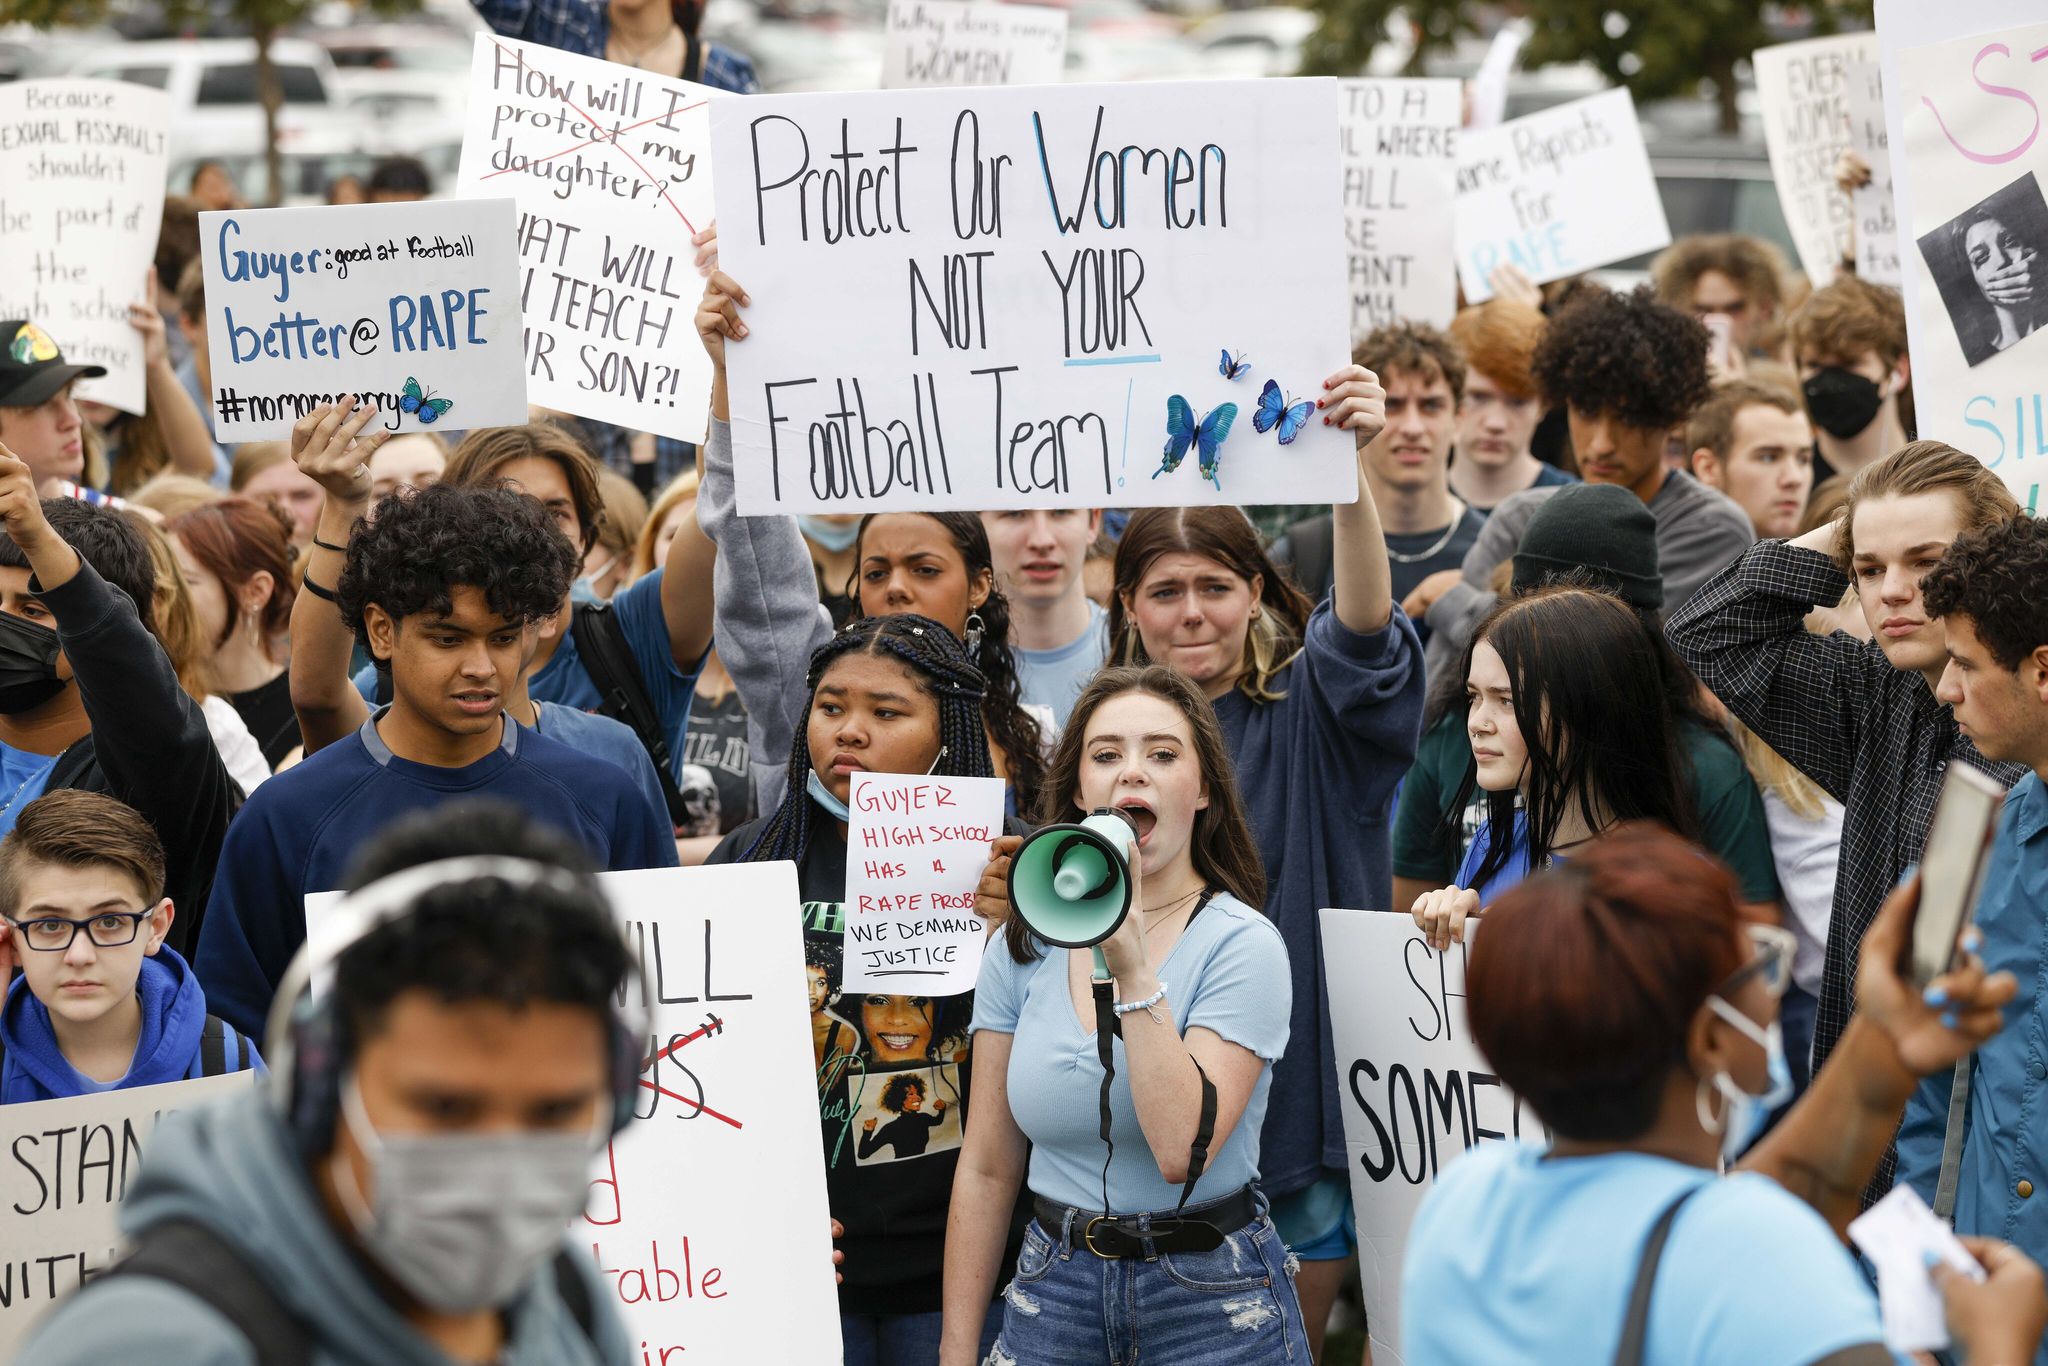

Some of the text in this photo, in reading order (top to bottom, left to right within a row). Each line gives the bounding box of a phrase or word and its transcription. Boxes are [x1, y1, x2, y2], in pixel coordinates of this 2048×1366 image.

[26, 87, 116, 111] Because
[494, 43, 686, 132] How will I
[1346, 85, 1385, 119] TO
[0, 119, 165, 154] EXUAL ASSAULT
[491, 104, 696, 183] protect my
[1377, 125, 1457, 158] WHERE
[491, 136, 669, 208] daughter?
[750, 104, 1227, 246] Protect Our Women
[1, 199, 31, 234] be
[57, 198, 113, 243] part
[377, 239, 400, 260] at
[602, 235, 680, 299] WILL
[33, 250, 87, 285] the
[388, 287, 491, 353] RAPE
[550, 272, 673, 349] TEACH
[908, 247, 1153, 359] NOT YOUR
[764, 372, 953, 502] Football
[856, 781, 957, 815] GUYER
[862, 824, 997, 848] HIGH SCHOOL
[865, 858, 946, 880] HAS A
[859, 893, 923, 914] RAPE
[850, 918, 982, 943] WE DEMAND
[861, 945, 958, 968] JUSTICE
[12, 1109, 180, 1215] STAN
